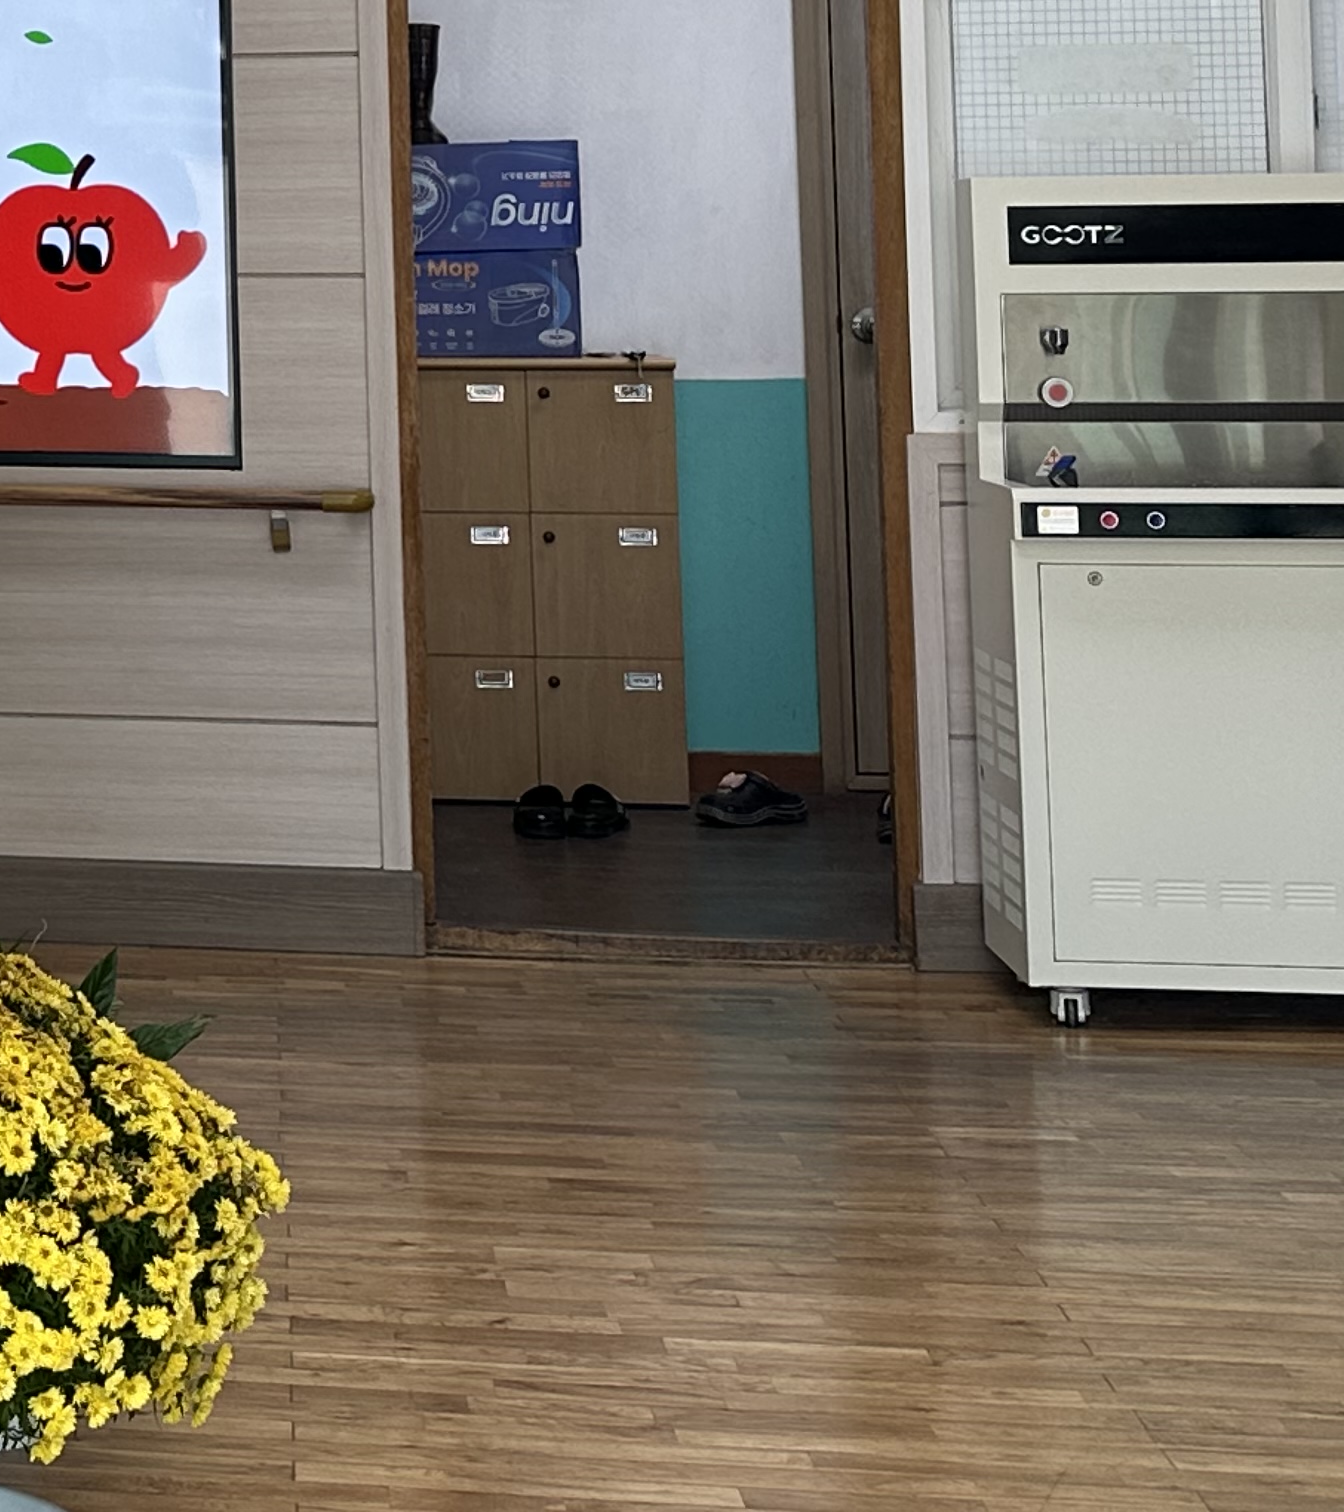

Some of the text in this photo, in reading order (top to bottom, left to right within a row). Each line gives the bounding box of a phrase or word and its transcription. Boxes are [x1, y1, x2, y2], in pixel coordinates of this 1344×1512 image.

[490, 193, 575, 232] ning
[1020, 224, 1125, 245] GOOTZ
[427, 261, 480, 281] Mop
